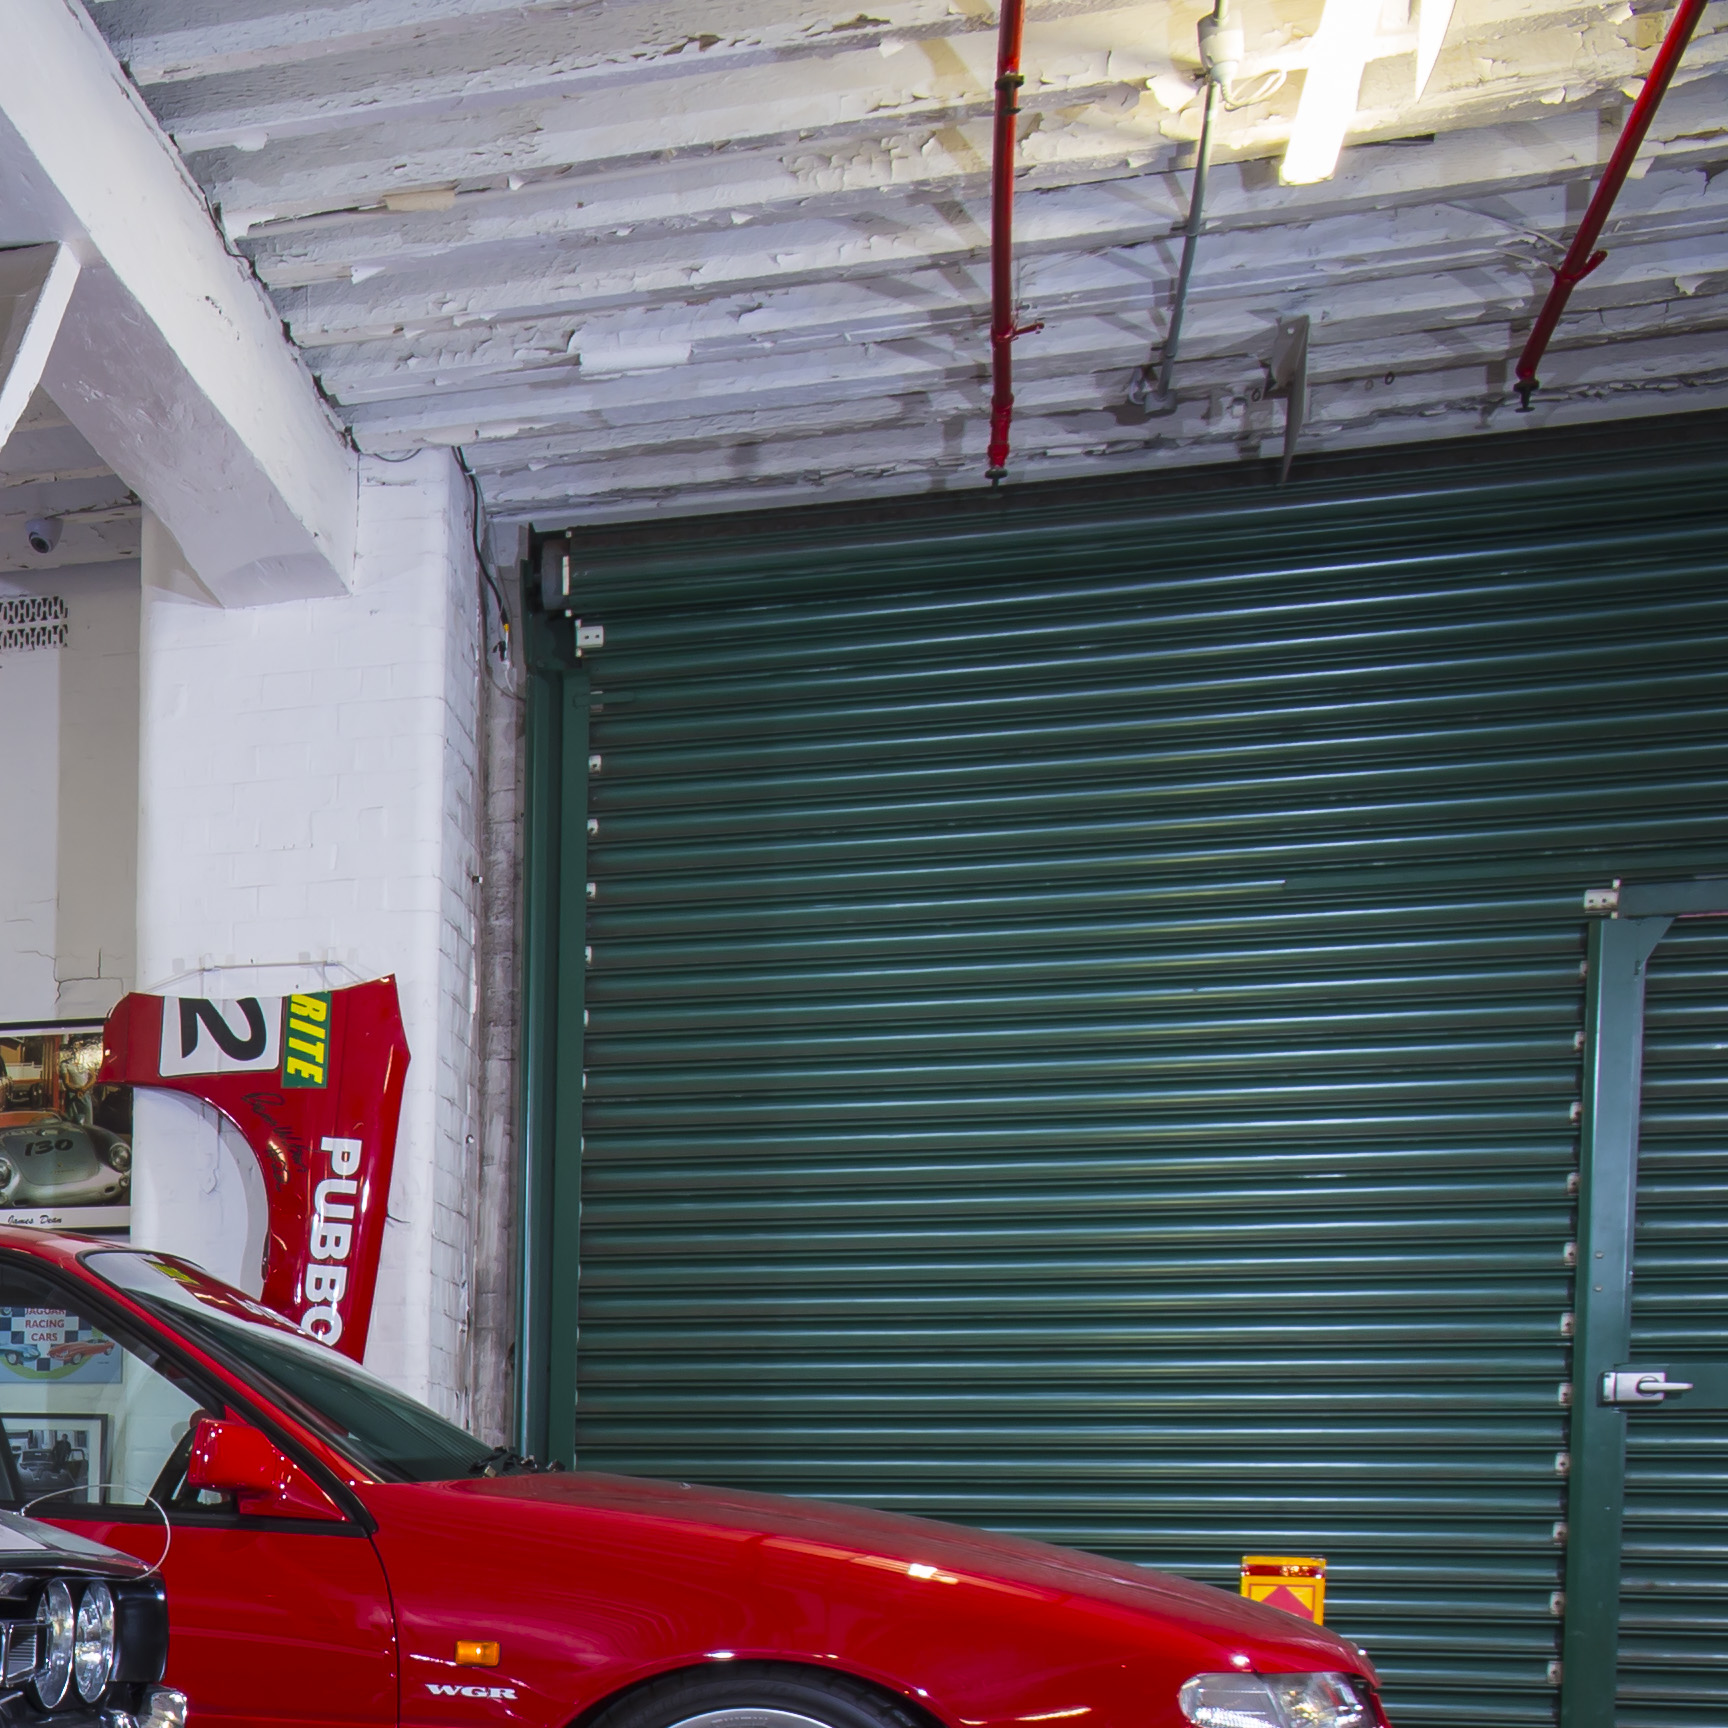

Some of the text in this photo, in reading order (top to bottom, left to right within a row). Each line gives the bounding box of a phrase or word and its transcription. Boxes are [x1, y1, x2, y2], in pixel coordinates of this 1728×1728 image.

[24, 1139, 74, 1157] 130
[7, 1214, 63, 1225] James Dean
[24, 1319, 65, 1329] RACING
[30, 1332, 58, 1342] CARS
[425, 1684, 519, 1700] WGR
